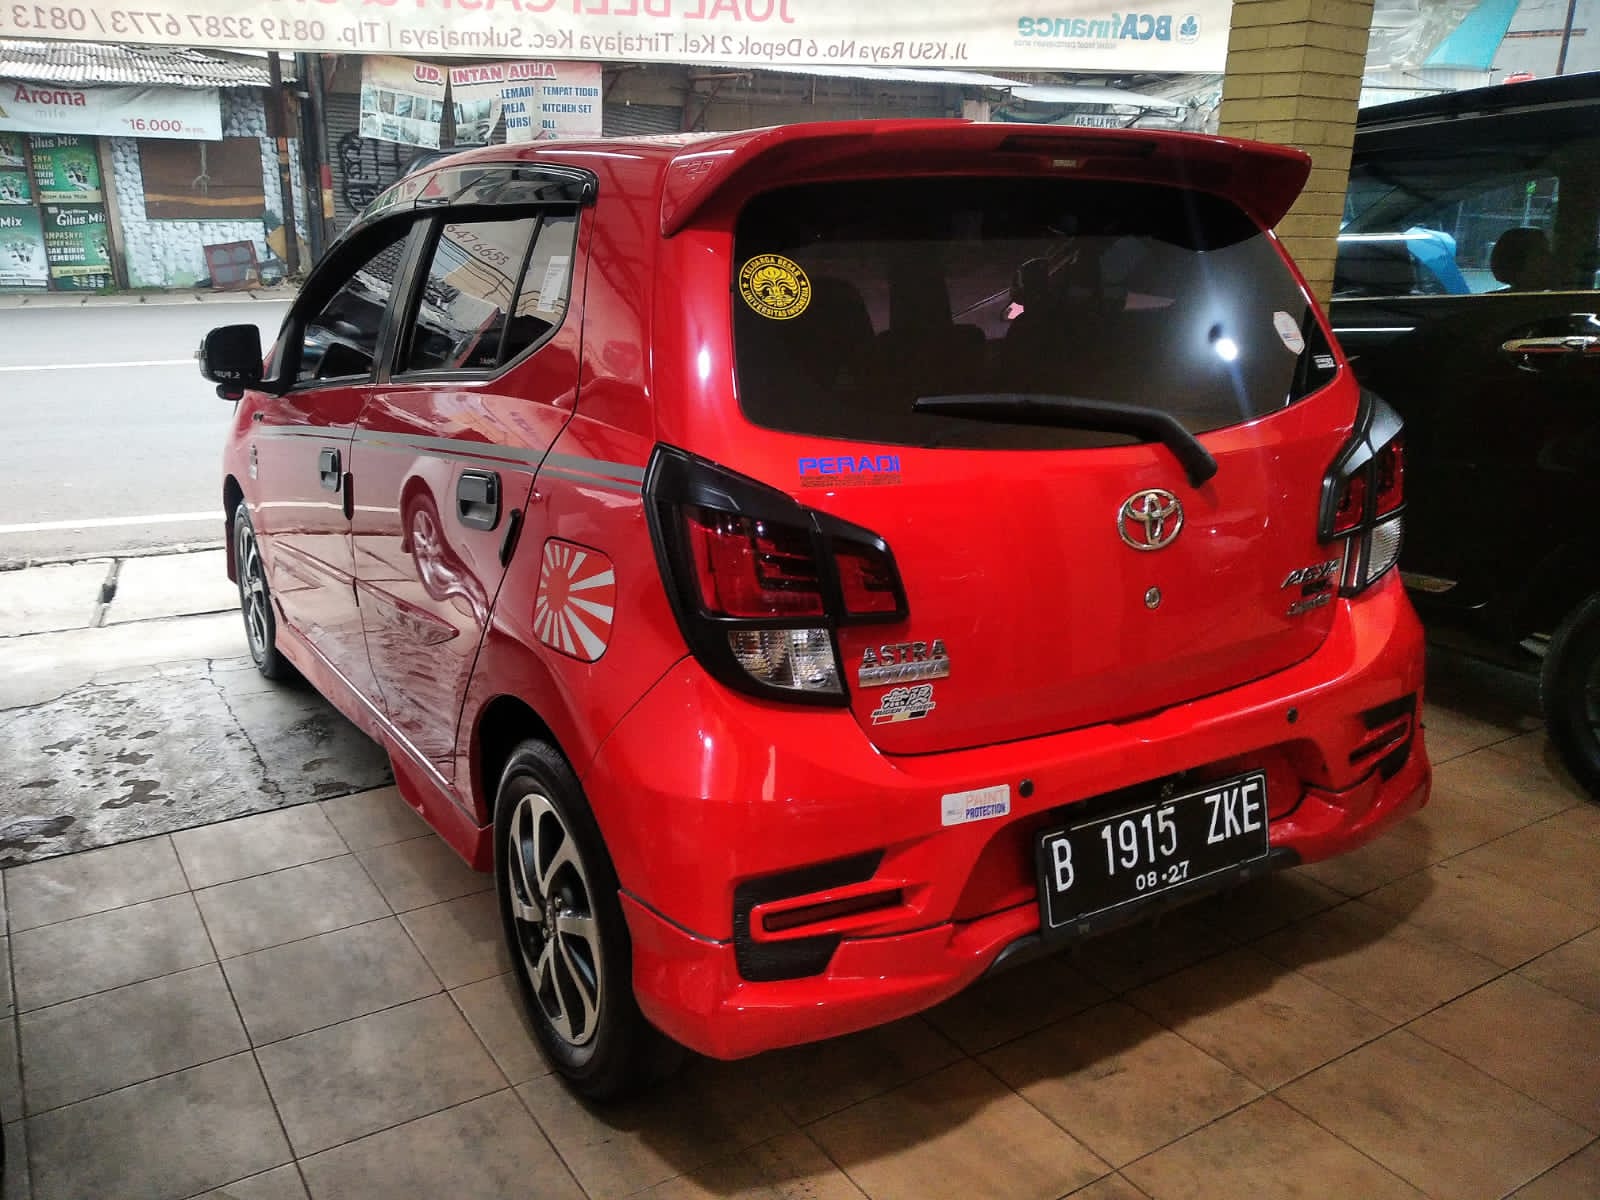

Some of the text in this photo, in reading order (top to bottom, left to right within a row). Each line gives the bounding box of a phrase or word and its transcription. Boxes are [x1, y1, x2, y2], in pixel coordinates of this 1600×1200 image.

[414, 64, 556, 83] UD. INTAN AULIA
[14, 83, 86, 106] Aroma
[501, 87, 534, 99] LEMARI
[543, 87, 599, 97] TEMPAT TIDUR
[502, 103, 525, 113] MEJA
[542, 104, 592, 113] KITCHEN SET
[56, 214, 86, 226] Gilus
[798, 455, 900, 475] PERADI
[860, 639, 950, 668] ASTRA
[965, 803, 1006, 819] PROTECTION
[1051, 783, 1261, 892] B 1915 ZKE
